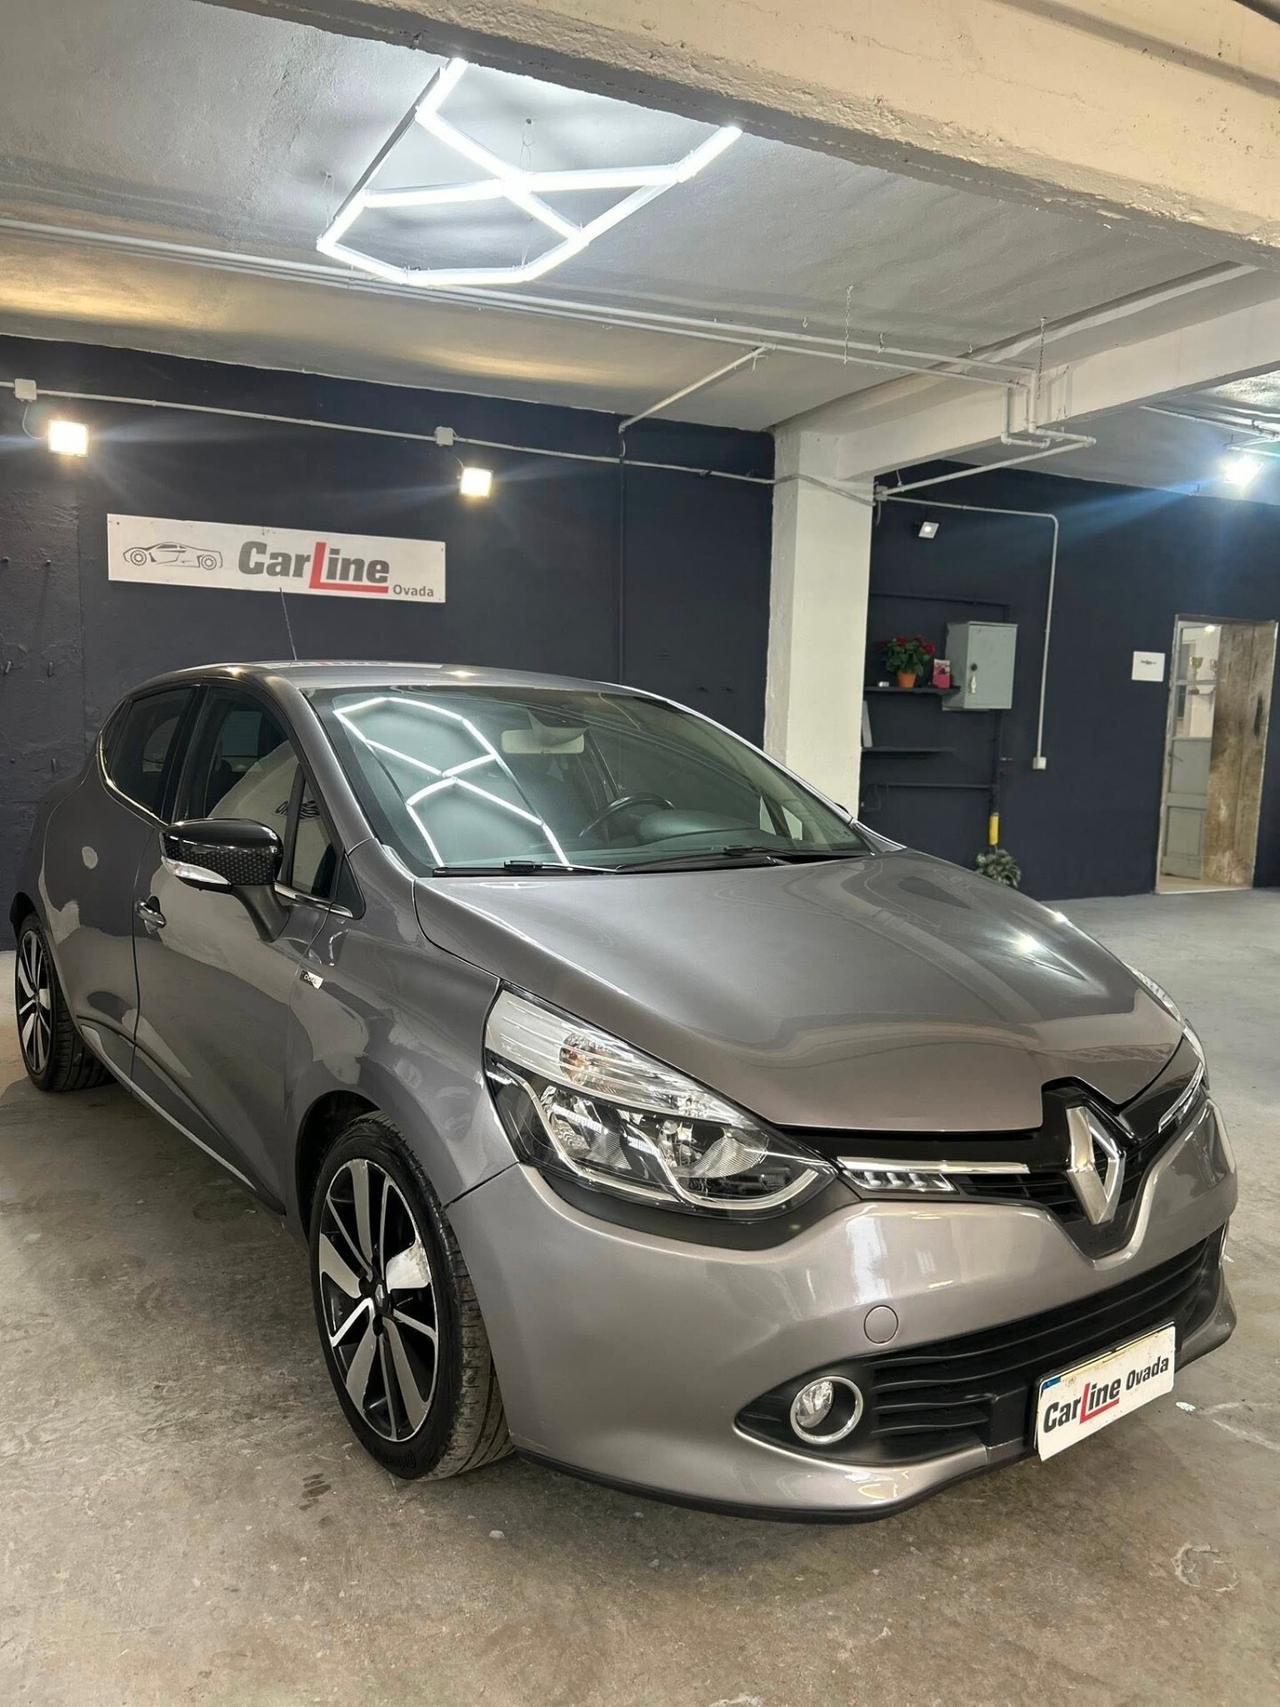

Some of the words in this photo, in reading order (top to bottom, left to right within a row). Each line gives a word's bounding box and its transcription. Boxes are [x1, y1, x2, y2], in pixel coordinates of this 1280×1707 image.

[239, 541, 389, 593] CarLine
[393, 584, 434, 598] Ovada
[1043, 1379, 1121, 1433] CarLine
[1126, 1356, 1168, 1391] Ovada
